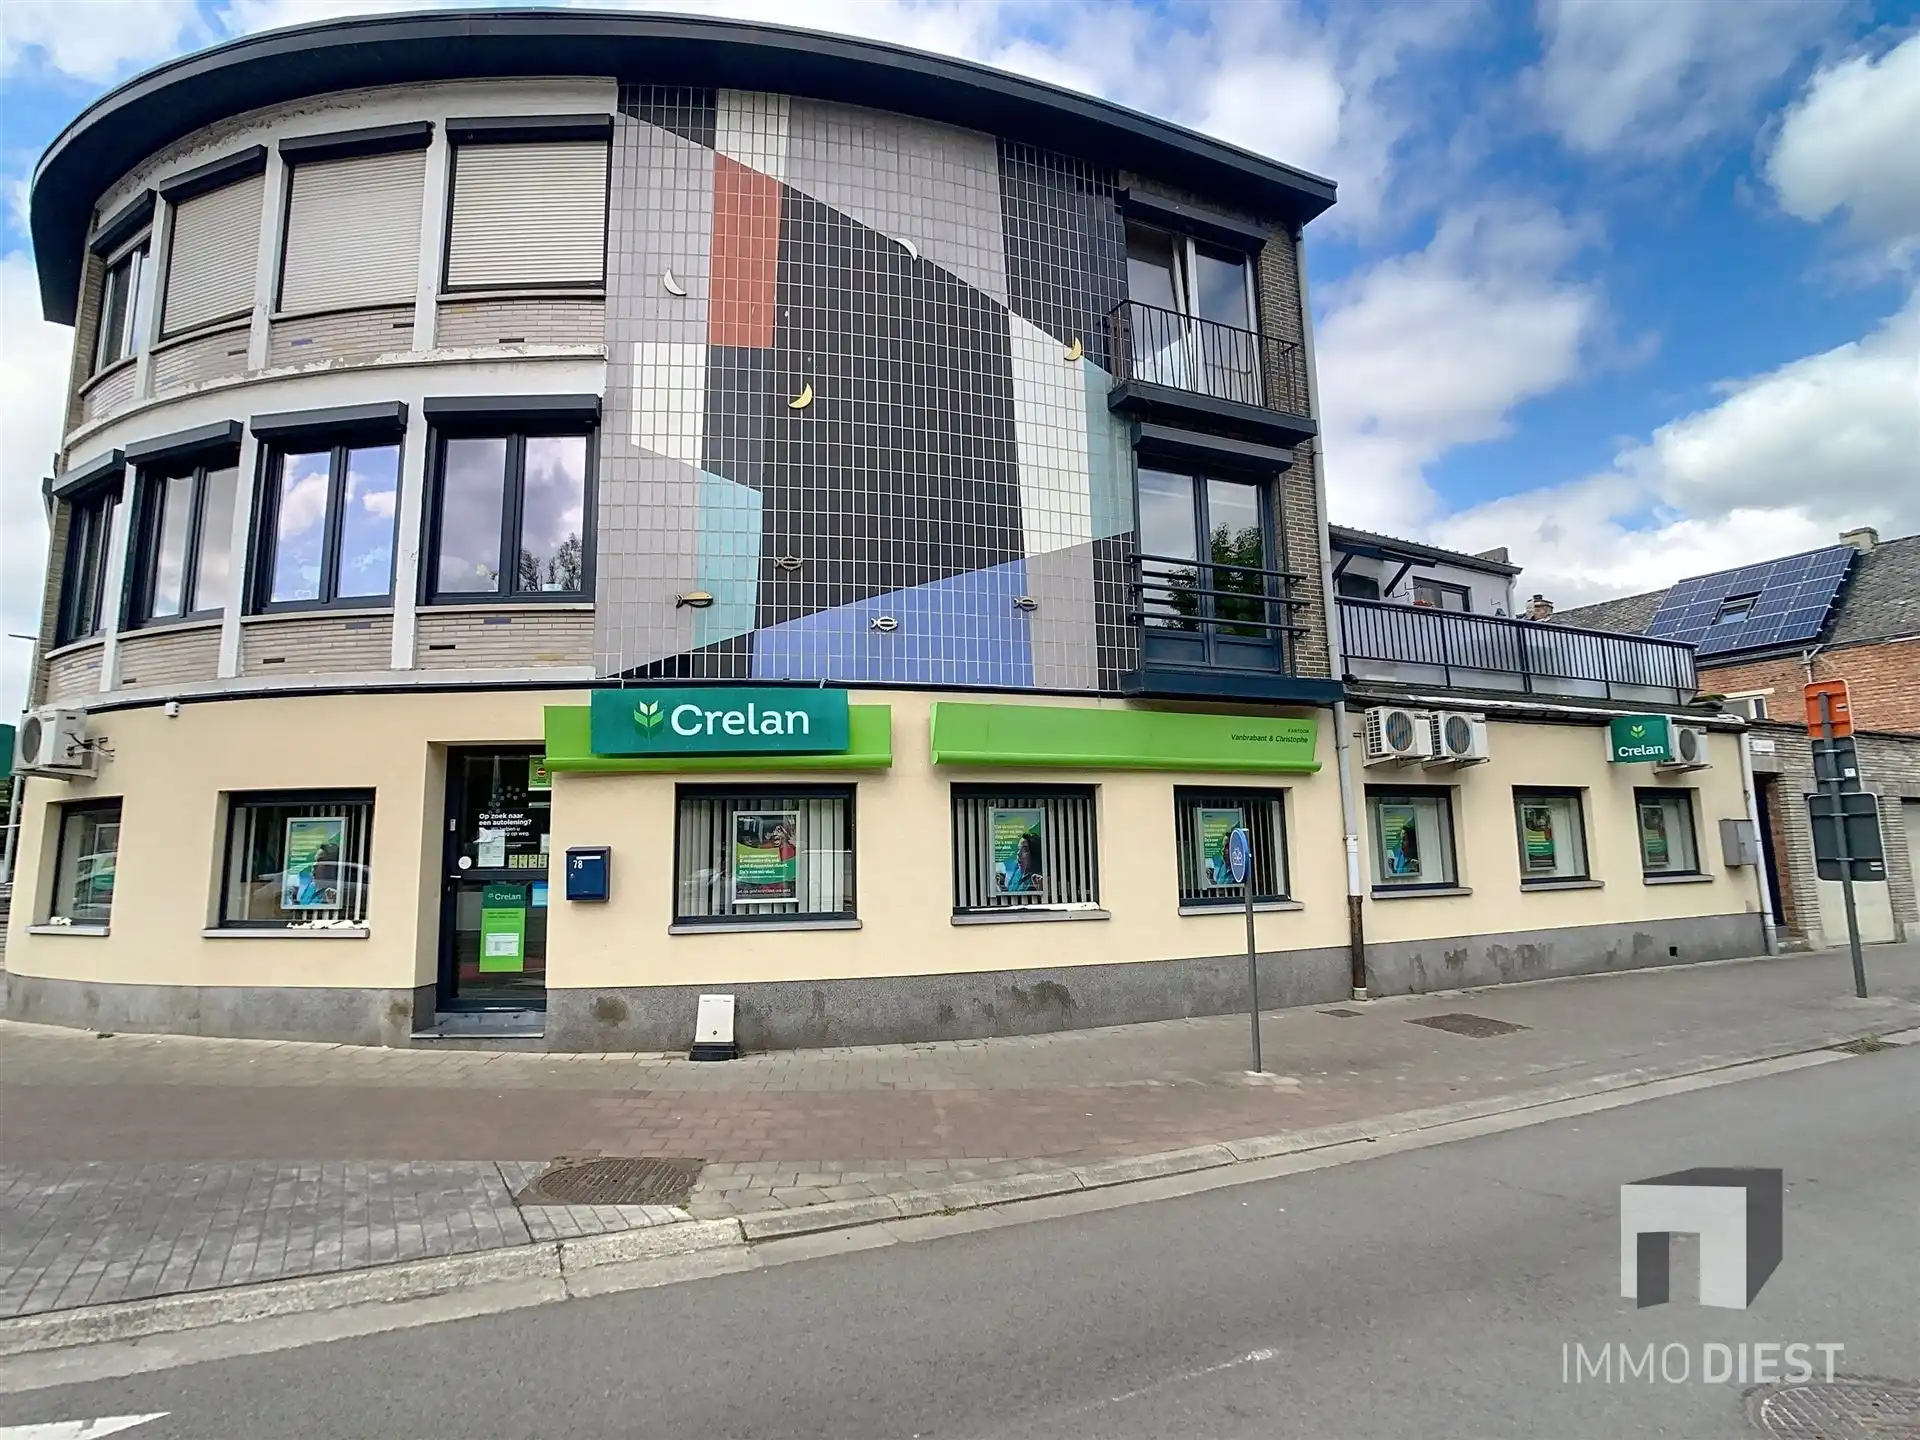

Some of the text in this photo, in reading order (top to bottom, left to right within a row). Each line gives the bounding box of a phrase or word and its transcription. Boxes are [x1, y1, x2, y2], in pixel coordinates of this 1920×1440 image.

[671, 702, 810, 736] Crelan
[1231, 734, 1267, 742] Vanbrabant
[1275, 735, 1309, 744] Christophe
[1618, 744, 1664, 757] Crelan
[492, 818, 532, 826] autolening?
[572, 859, 583, 869] 78
[494, 893, 521, 901] Crelan
